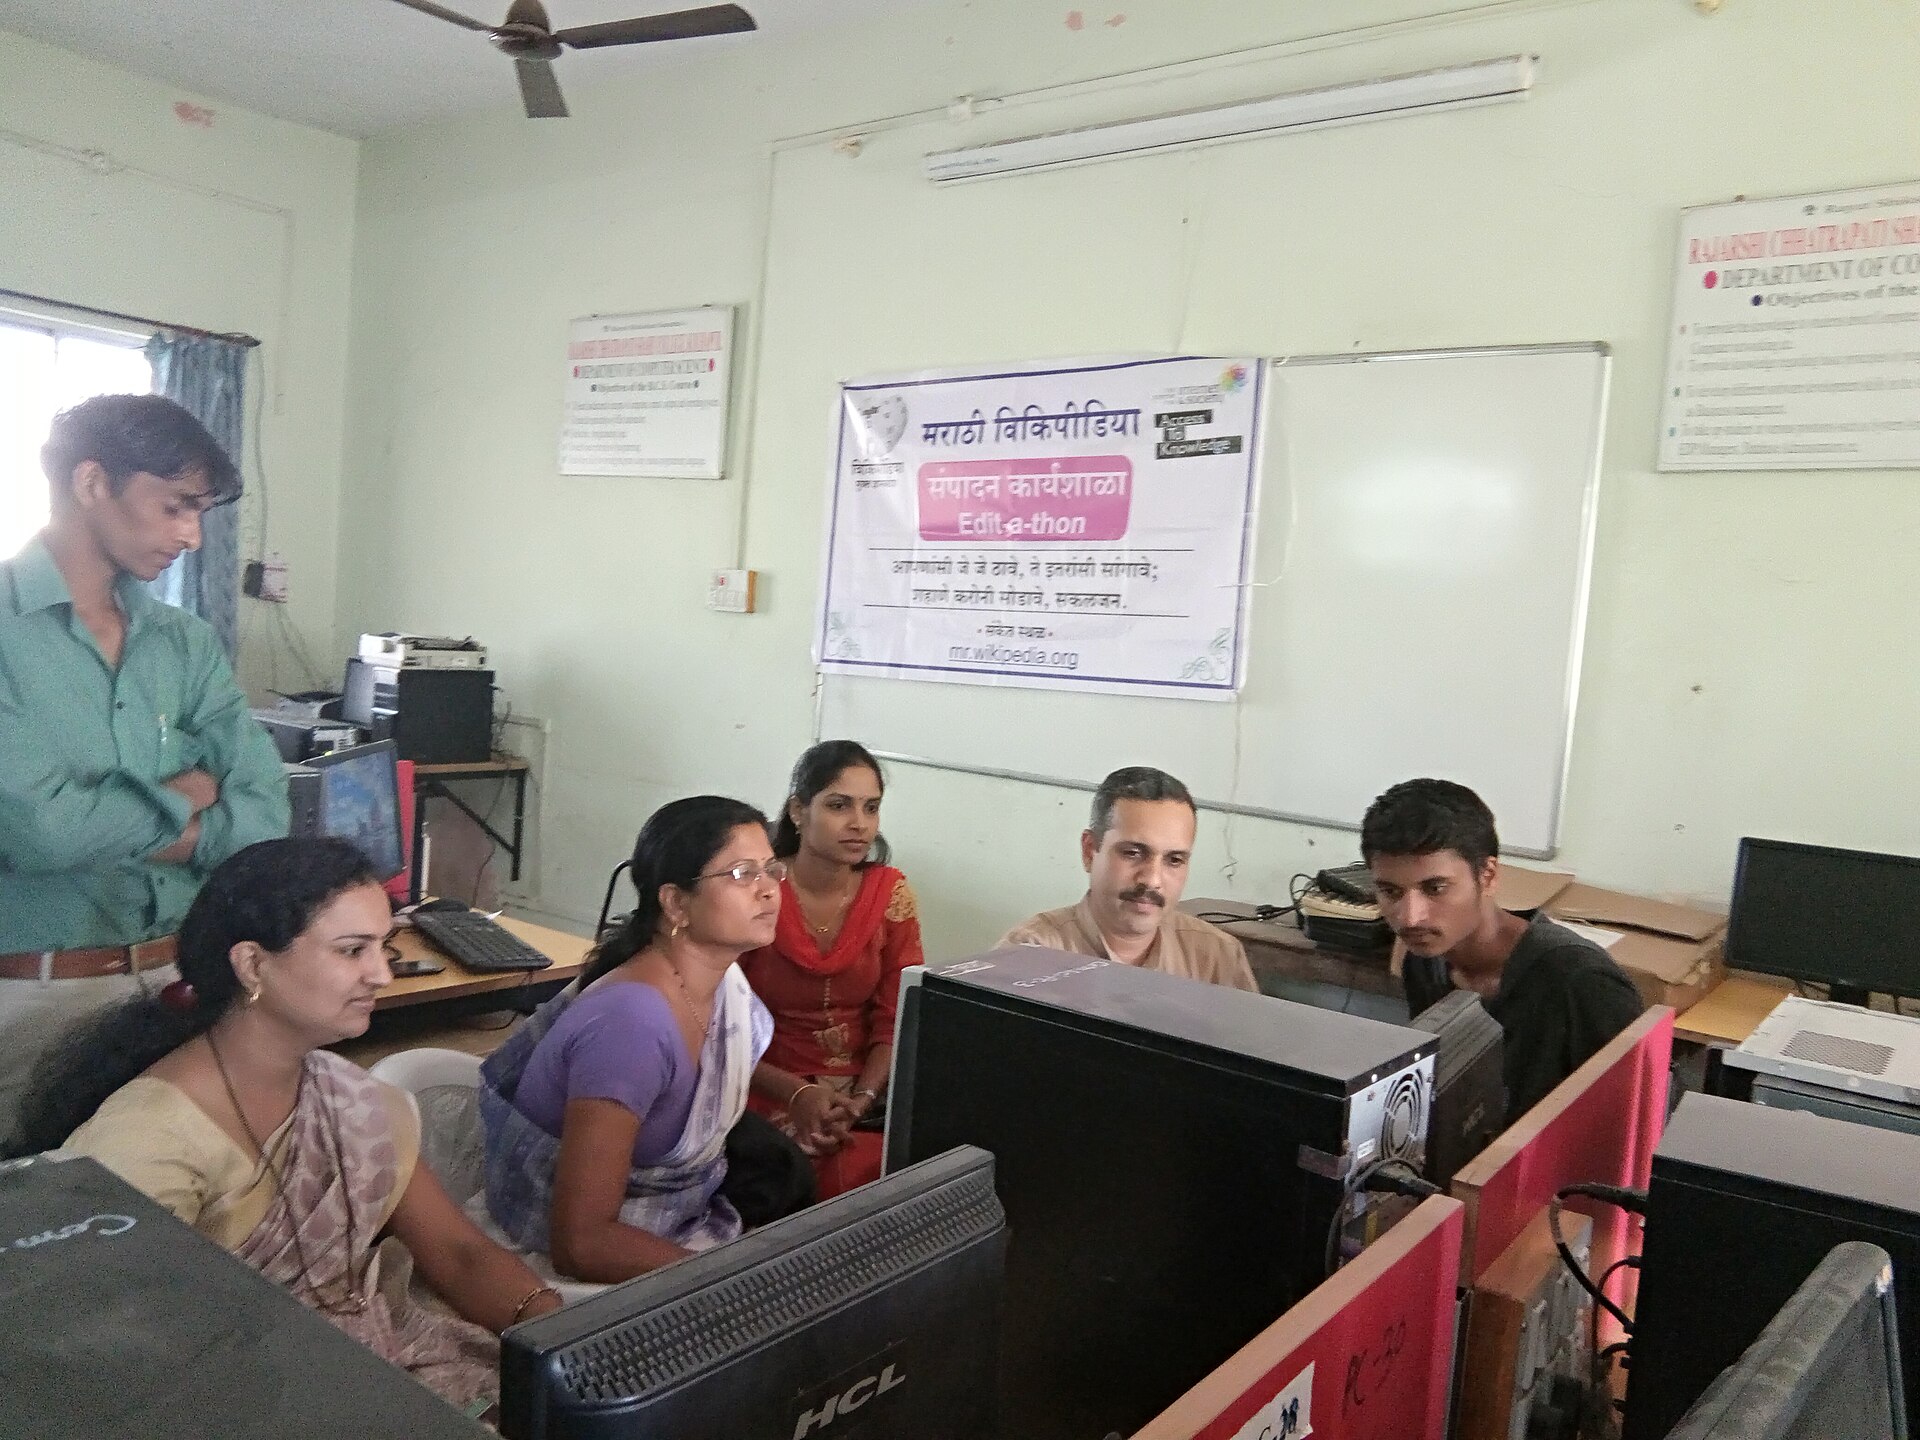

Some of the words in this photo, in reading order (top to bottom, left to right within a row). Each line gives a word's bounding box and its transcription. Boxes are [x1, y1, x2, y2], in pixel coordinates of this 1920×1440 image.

[1721, 259, 1854, 289] DEPARTMENT
[1857, 256, 1890, 279] OF
[922, 408, 986, 446] मराठी
[993, 399, 1142, 444] विकिपीडिया
[926, 467, 1001, 502] संपादन
[1006, 462, 1129, 499] कार्यशाळा
[957, 511, 1087, 536] Edit-a-thon
[949, 644, 1079, 668] mr.wikipedia.org
[792, 1362, 906, 1440] HCL
